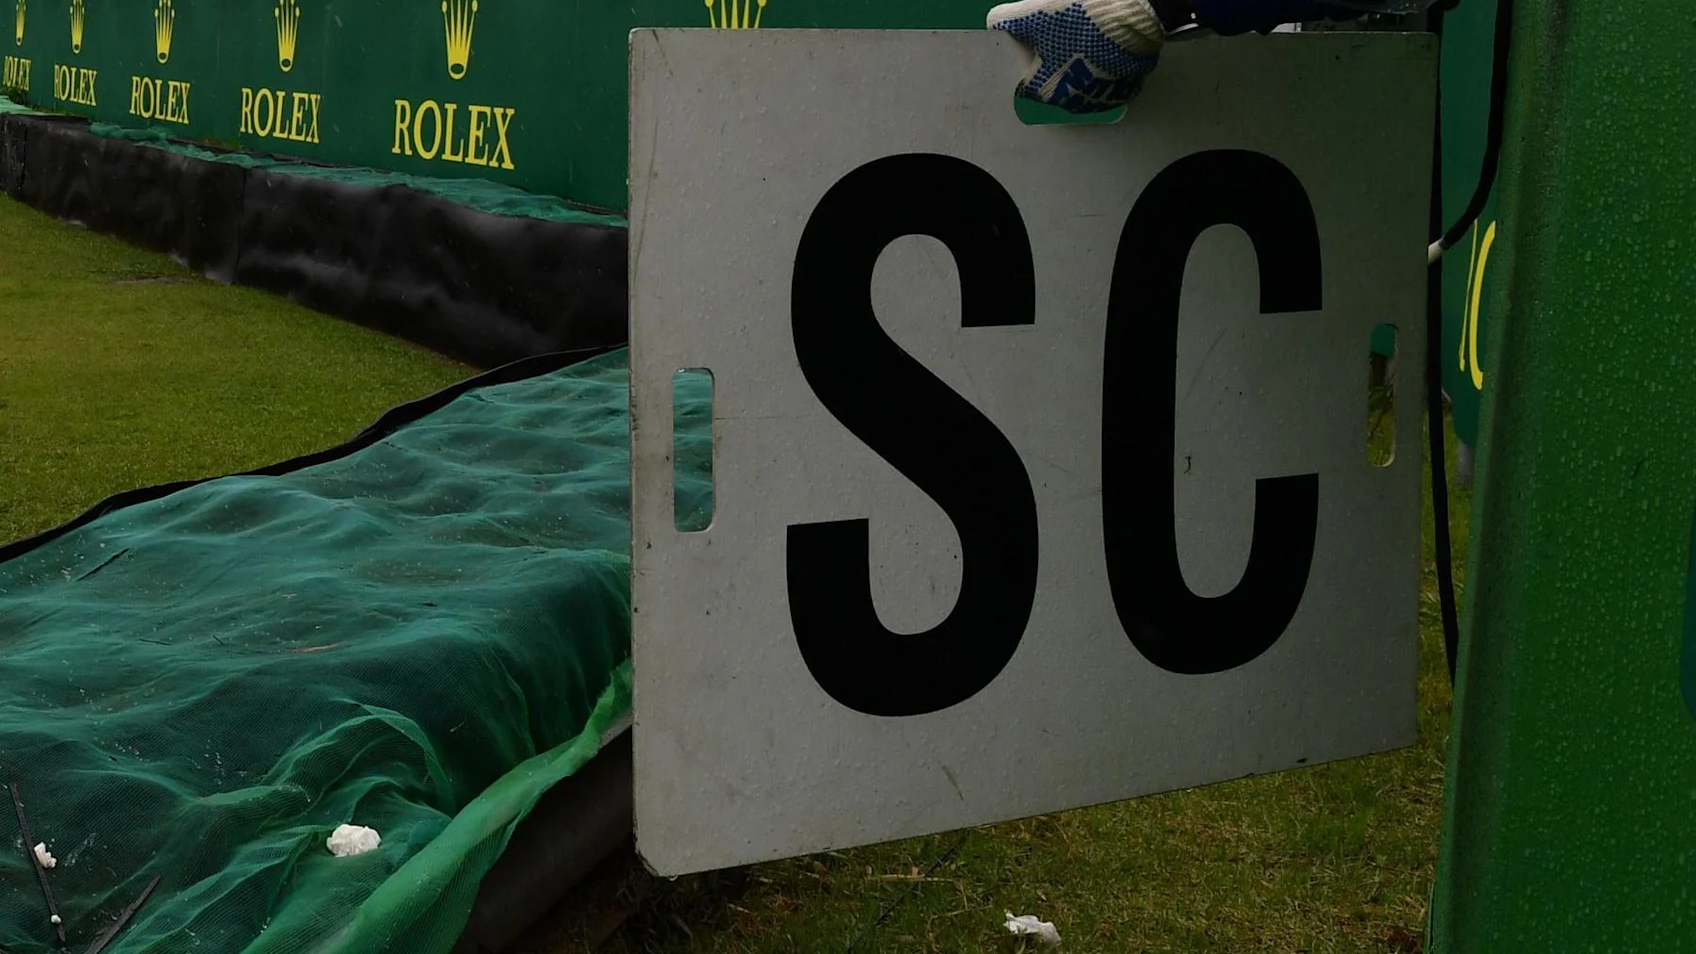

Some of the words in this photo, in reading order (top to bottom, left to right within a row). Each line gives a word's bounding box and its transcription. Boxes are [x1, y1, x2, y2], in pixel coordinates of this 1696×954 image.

[54, 63, 98, 107] ROLEX
[129, 75, 191, 125] ROLEX
[240, 87, 321, 144] ROLEX
[390, 99, 515, 170] ROLEX
[786, 147, 1323, 718] SC
